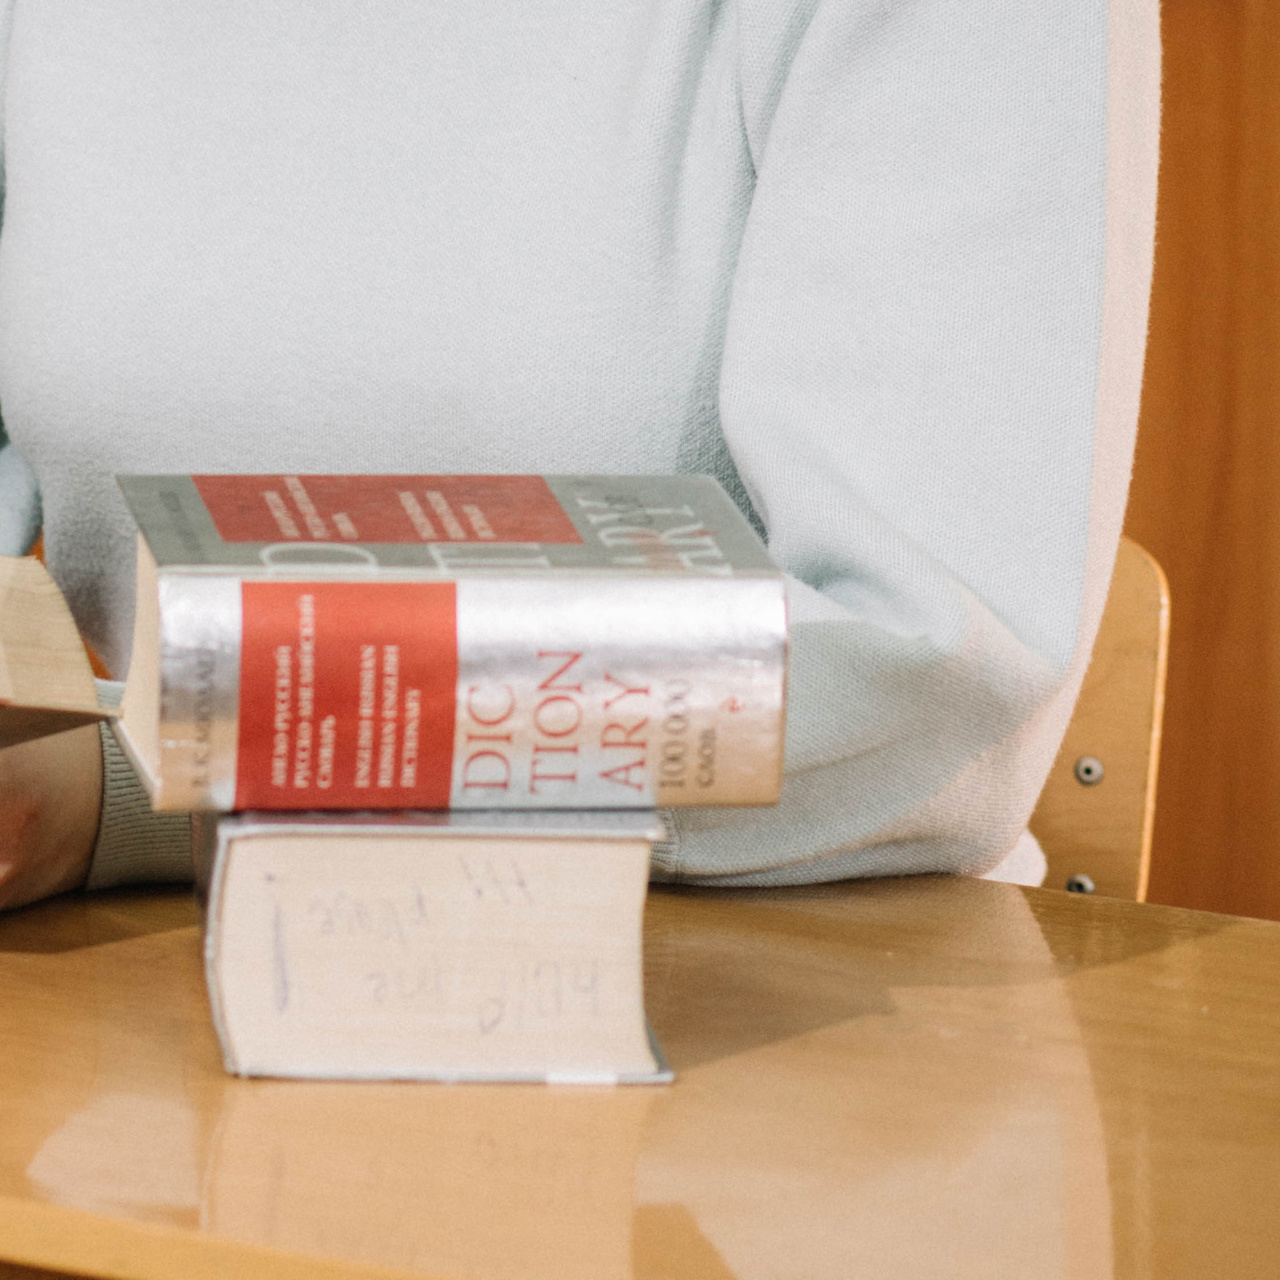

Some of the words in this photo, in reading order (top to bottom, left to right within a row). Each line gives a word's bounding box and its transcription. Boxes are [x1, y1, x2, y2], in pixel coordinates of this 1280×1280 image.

[462, 684, 516, 792] DIC
[529, 648, 583, 794] TION
[598, 670, 650, 793] ARY
